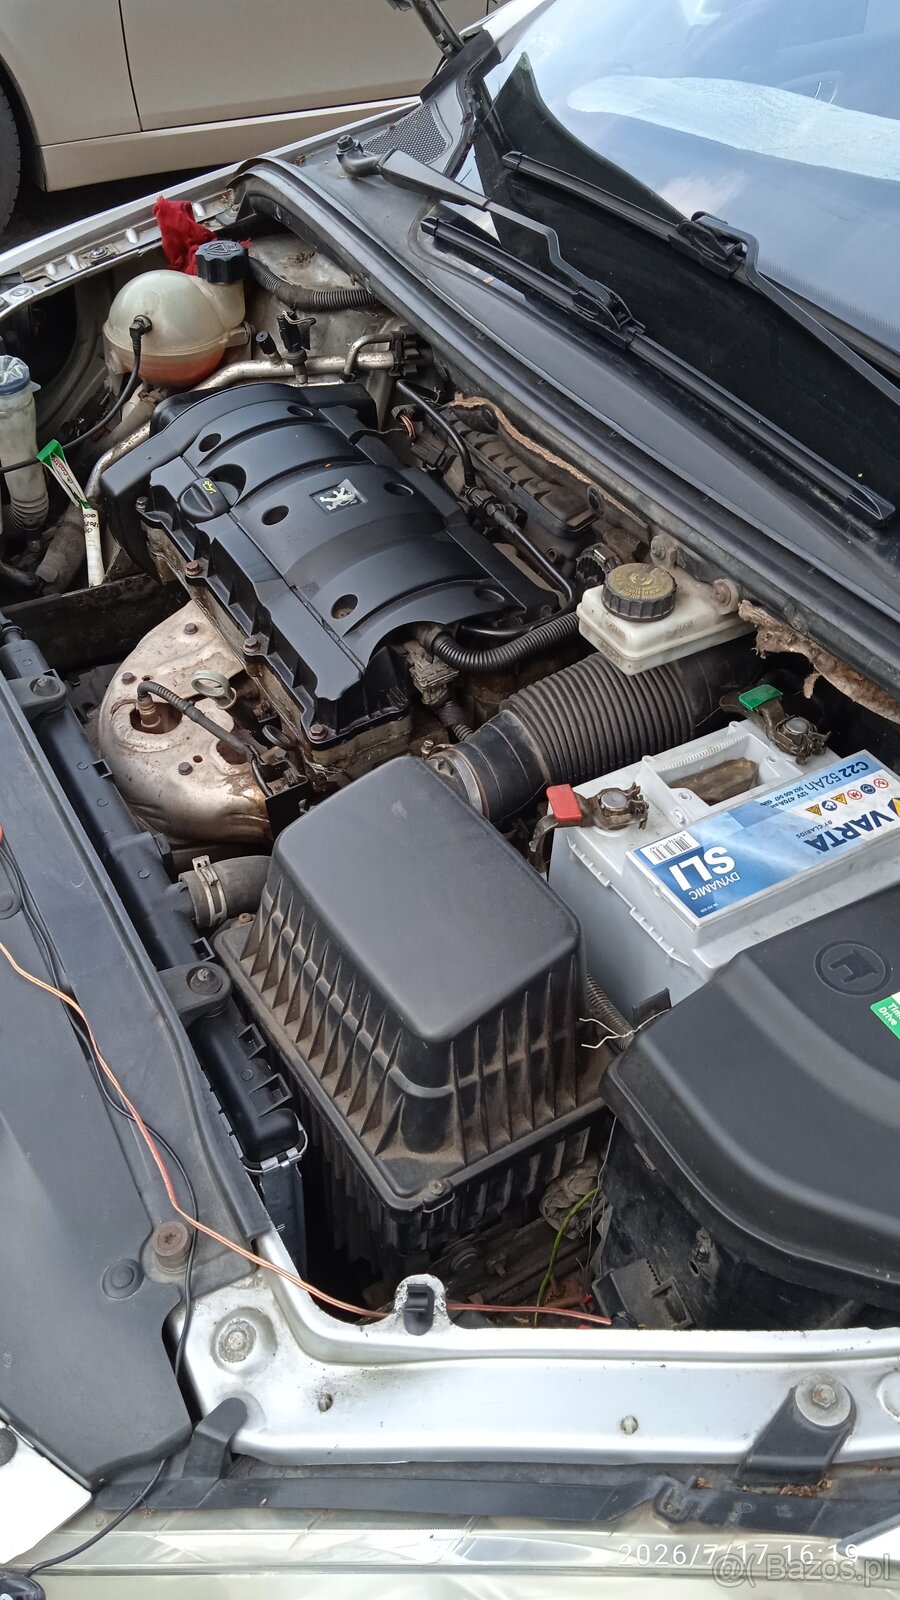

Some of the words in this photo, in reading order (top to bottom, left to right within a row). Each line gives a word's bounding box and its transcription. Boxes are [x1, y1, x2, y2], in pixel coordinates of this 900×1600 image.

[838, 761, 869, 778] C22
[804, 771, 839, 793] 52Ah
[796, 790, 809, 799] 12V
[795, 822, 822, 840] CLARIOS
[803, 810, 894, 853] VARTA
[822, 819, 833, 827] BY
[668, 846, 736, 891] SLI
[688, 871, 741, 900] DYNAMIC
[878, 1006, 898, 1026] Drive
